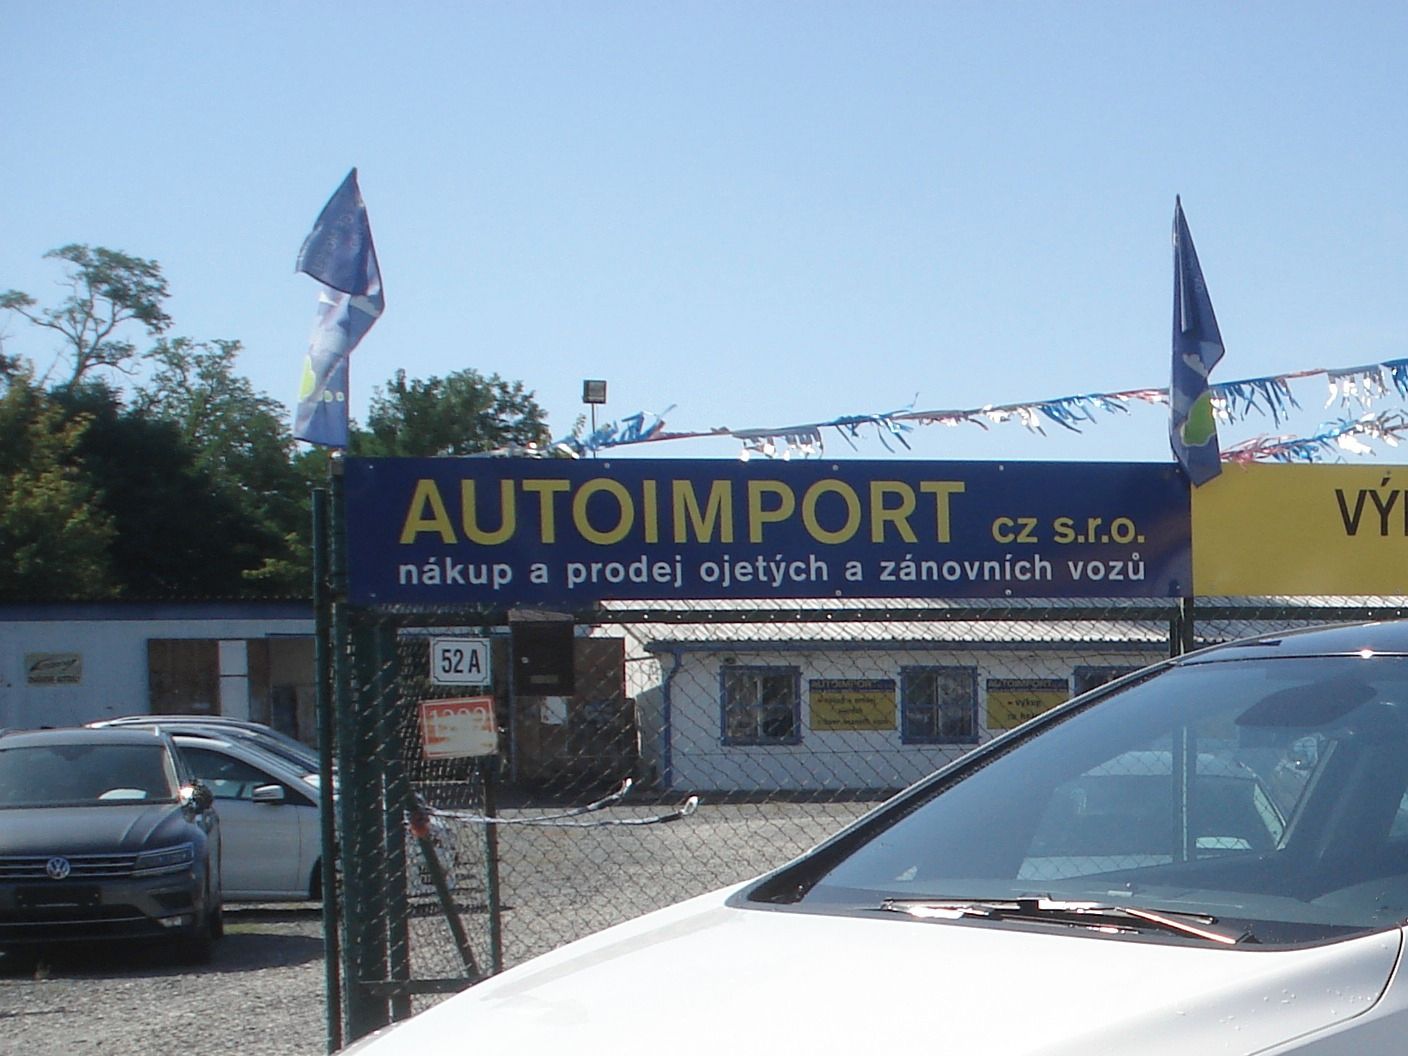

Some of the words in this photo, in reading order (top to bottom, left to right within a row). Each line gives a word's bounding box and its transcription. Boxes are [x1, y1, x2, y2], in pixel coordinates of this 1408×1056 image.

[400, 477, 965, 545] AUTOIMPORT
[991, 517, 1038, 544] cz
[1054, 517, 1146, 544] s.r.o.
[399, 556, 512, 590] nákup
[530, 562, 548, 584] a
[567, 553, 683, 590] prodej
[701, 553, 829, 588] ojetých
[845, 560, 863, 582] a
[880, 552, 1052, 582] zánovních
[1067, 551, 1146, 582] vozů
[442, 649, 464, 674] 52
[468, 649, 481, 674] A
